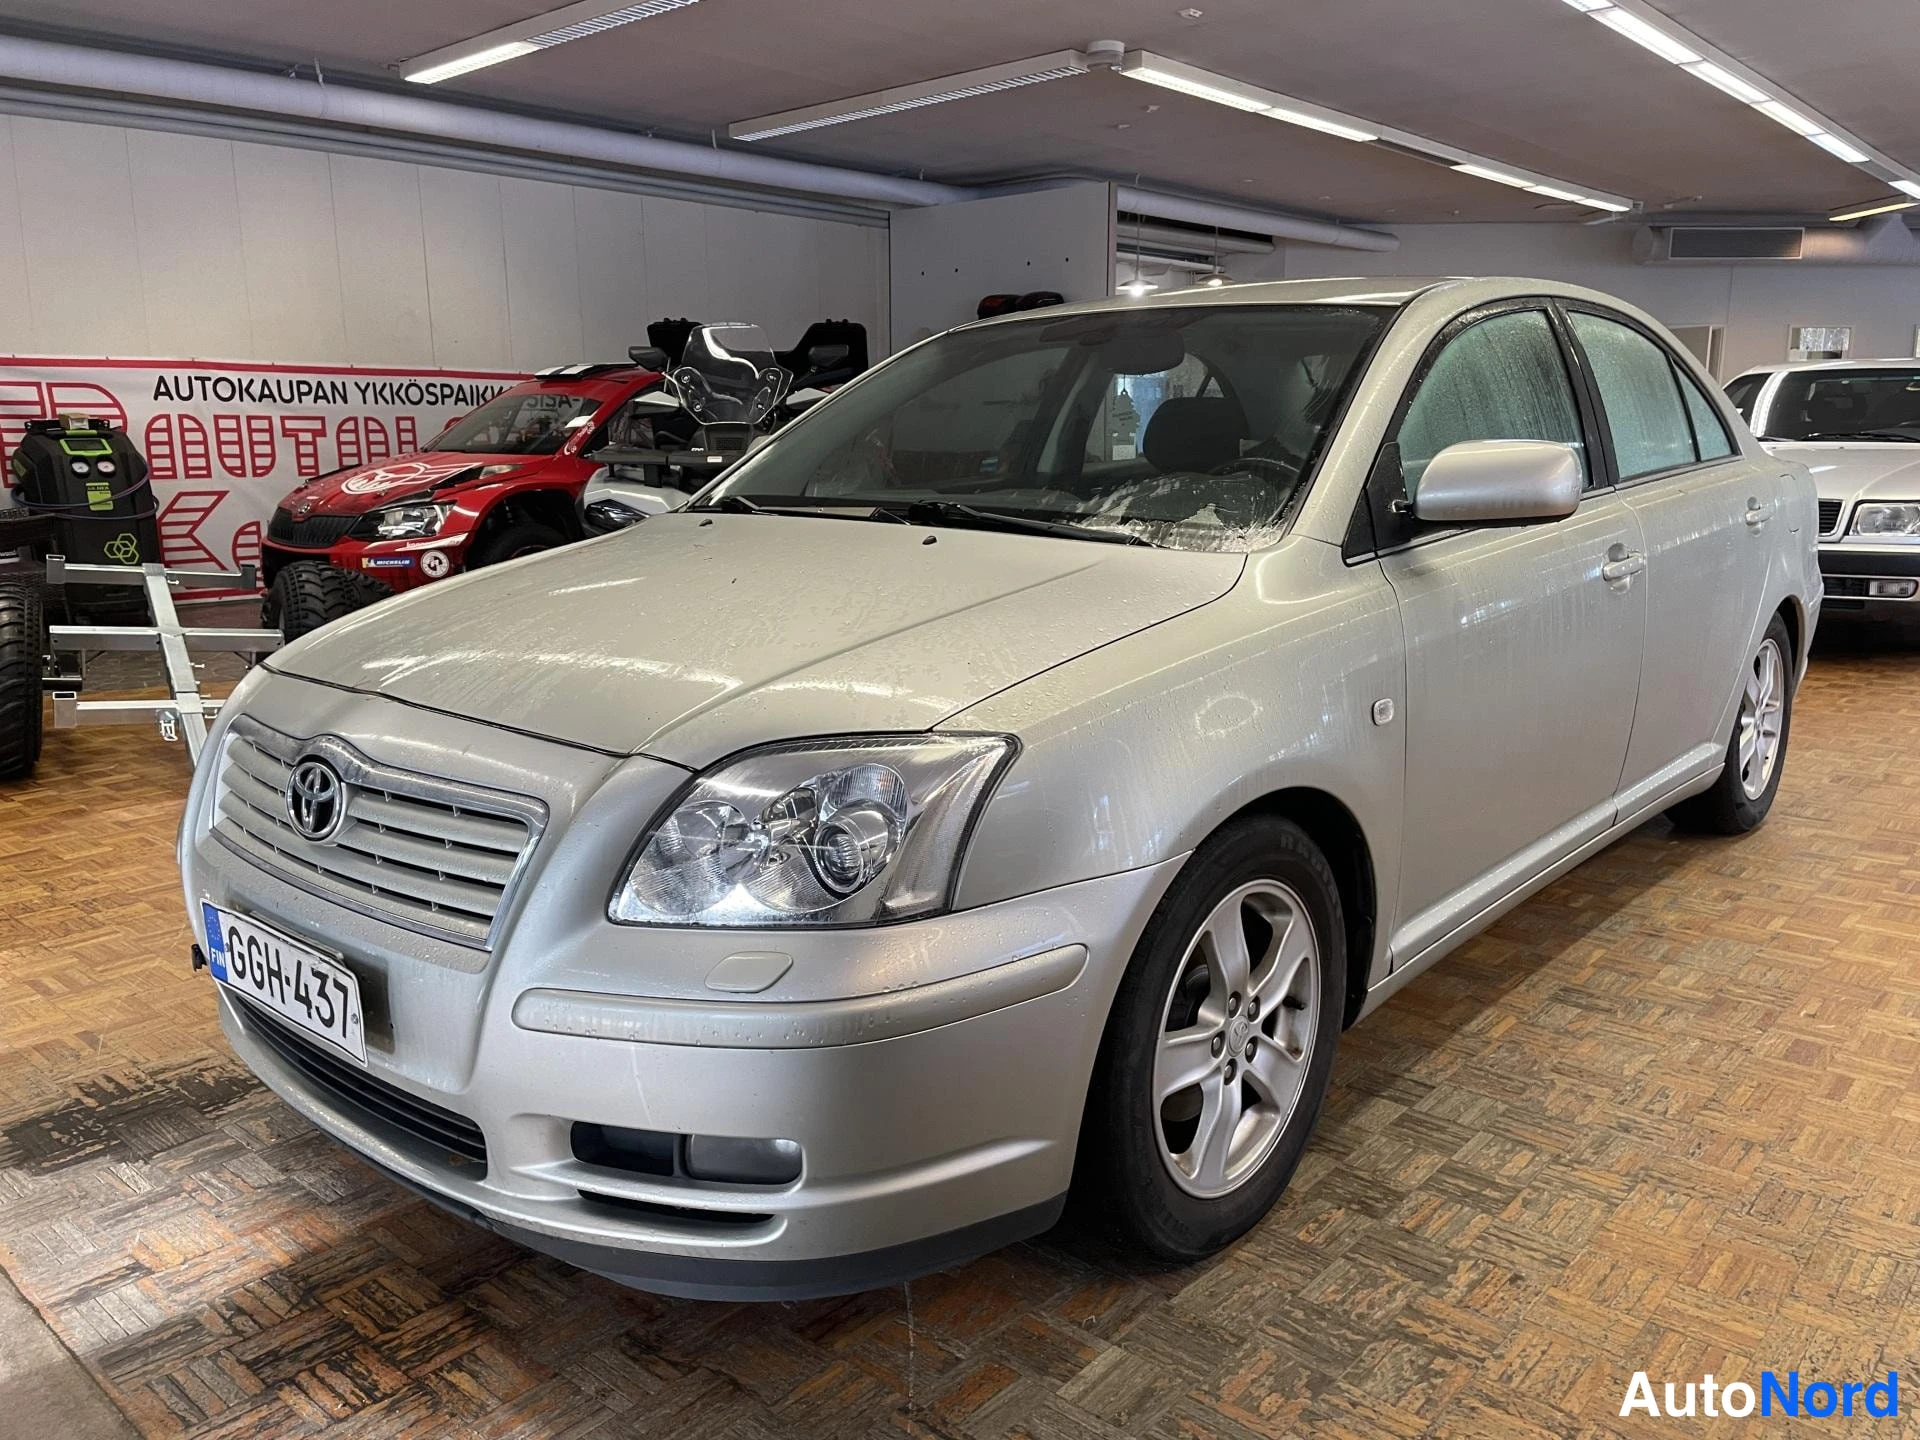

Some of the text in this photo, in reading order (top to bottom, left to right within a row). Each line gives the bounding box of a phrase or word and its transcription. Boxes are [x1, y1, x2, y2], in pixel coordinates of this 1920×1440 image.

[153, 375, 349, 405] AUTOKAUPAN
[210, 947, 226, 968] FIN
[228, 925, 349, 1039] GGH-437
